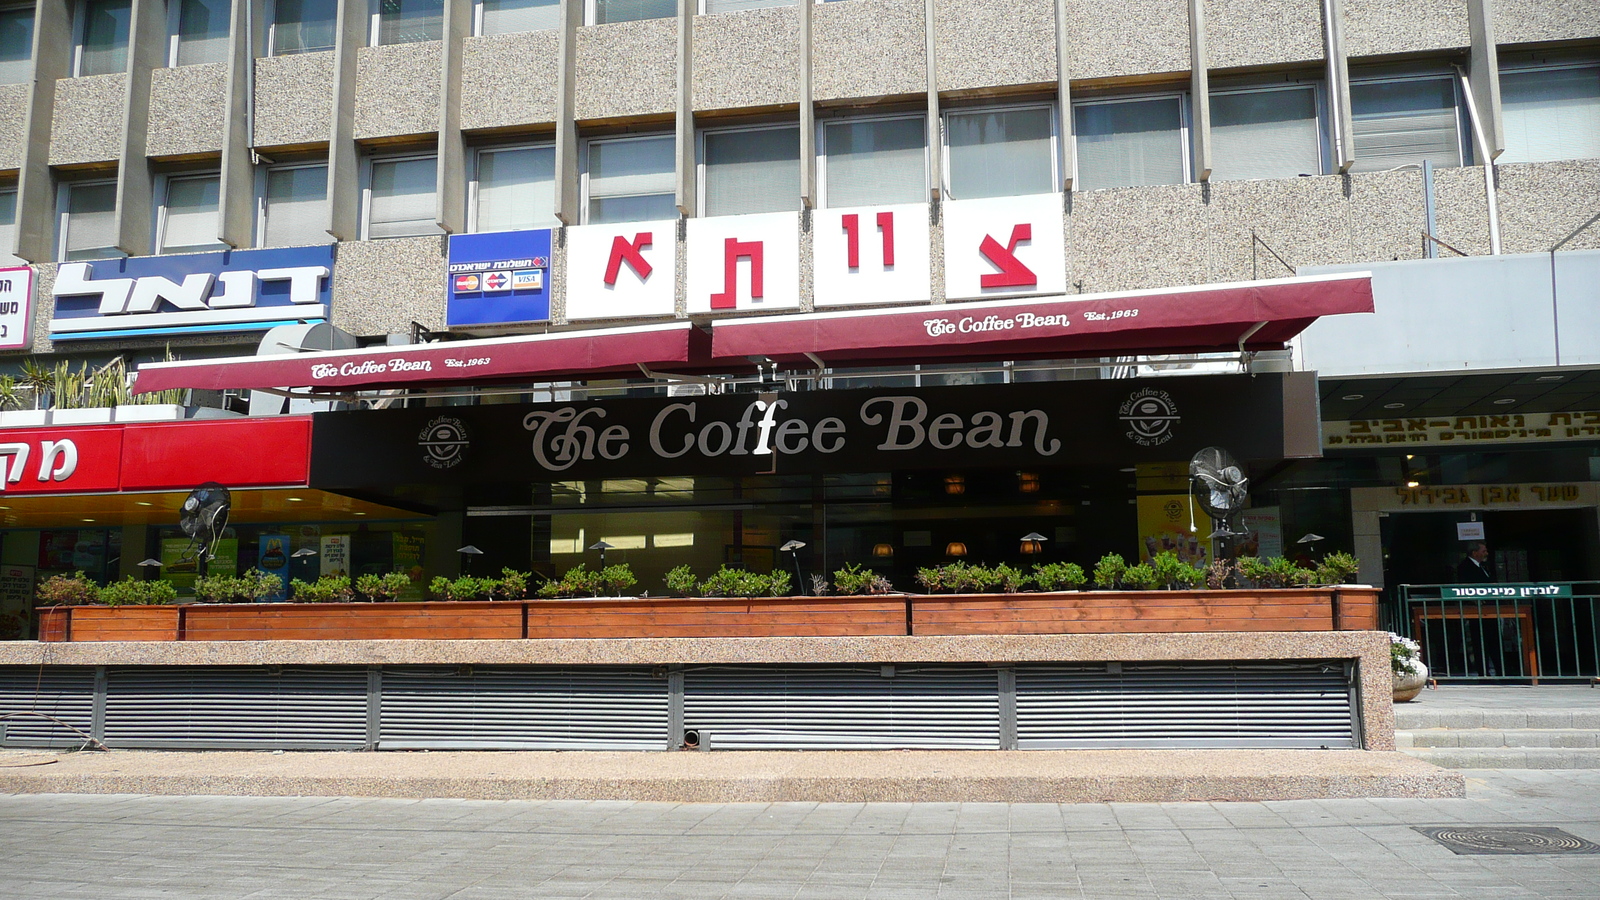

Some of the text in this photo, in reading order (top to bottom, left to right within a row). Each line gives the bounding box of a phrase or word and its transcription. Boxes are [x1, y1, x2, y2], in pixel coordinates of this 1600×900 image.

[603, 211, 1038, 311] צוותא
[52, 263, 330, 316] דנאל
[923, 319, 956, 337] The
[958, 315, 1014, 333] Coffee
[1015, 312, 1070, 328] Bean
[311, 363, 338, 379] The
[340, 361, 386, 376] Coffee
[388, 358, 432, 372] Bean
[1130, 387, 1158, 401] Coffee
[1160, 390, 1178, 416] Bean
[428, 415, 452, 428] Coffee
[522, 395, 1062, 471] The Coffee Bean
[1481, 487, 1522, 506] אבן
[1531, 485, 1580, 502] שער
[1451, 585, 1560, 597] לונדון מיניסטור
